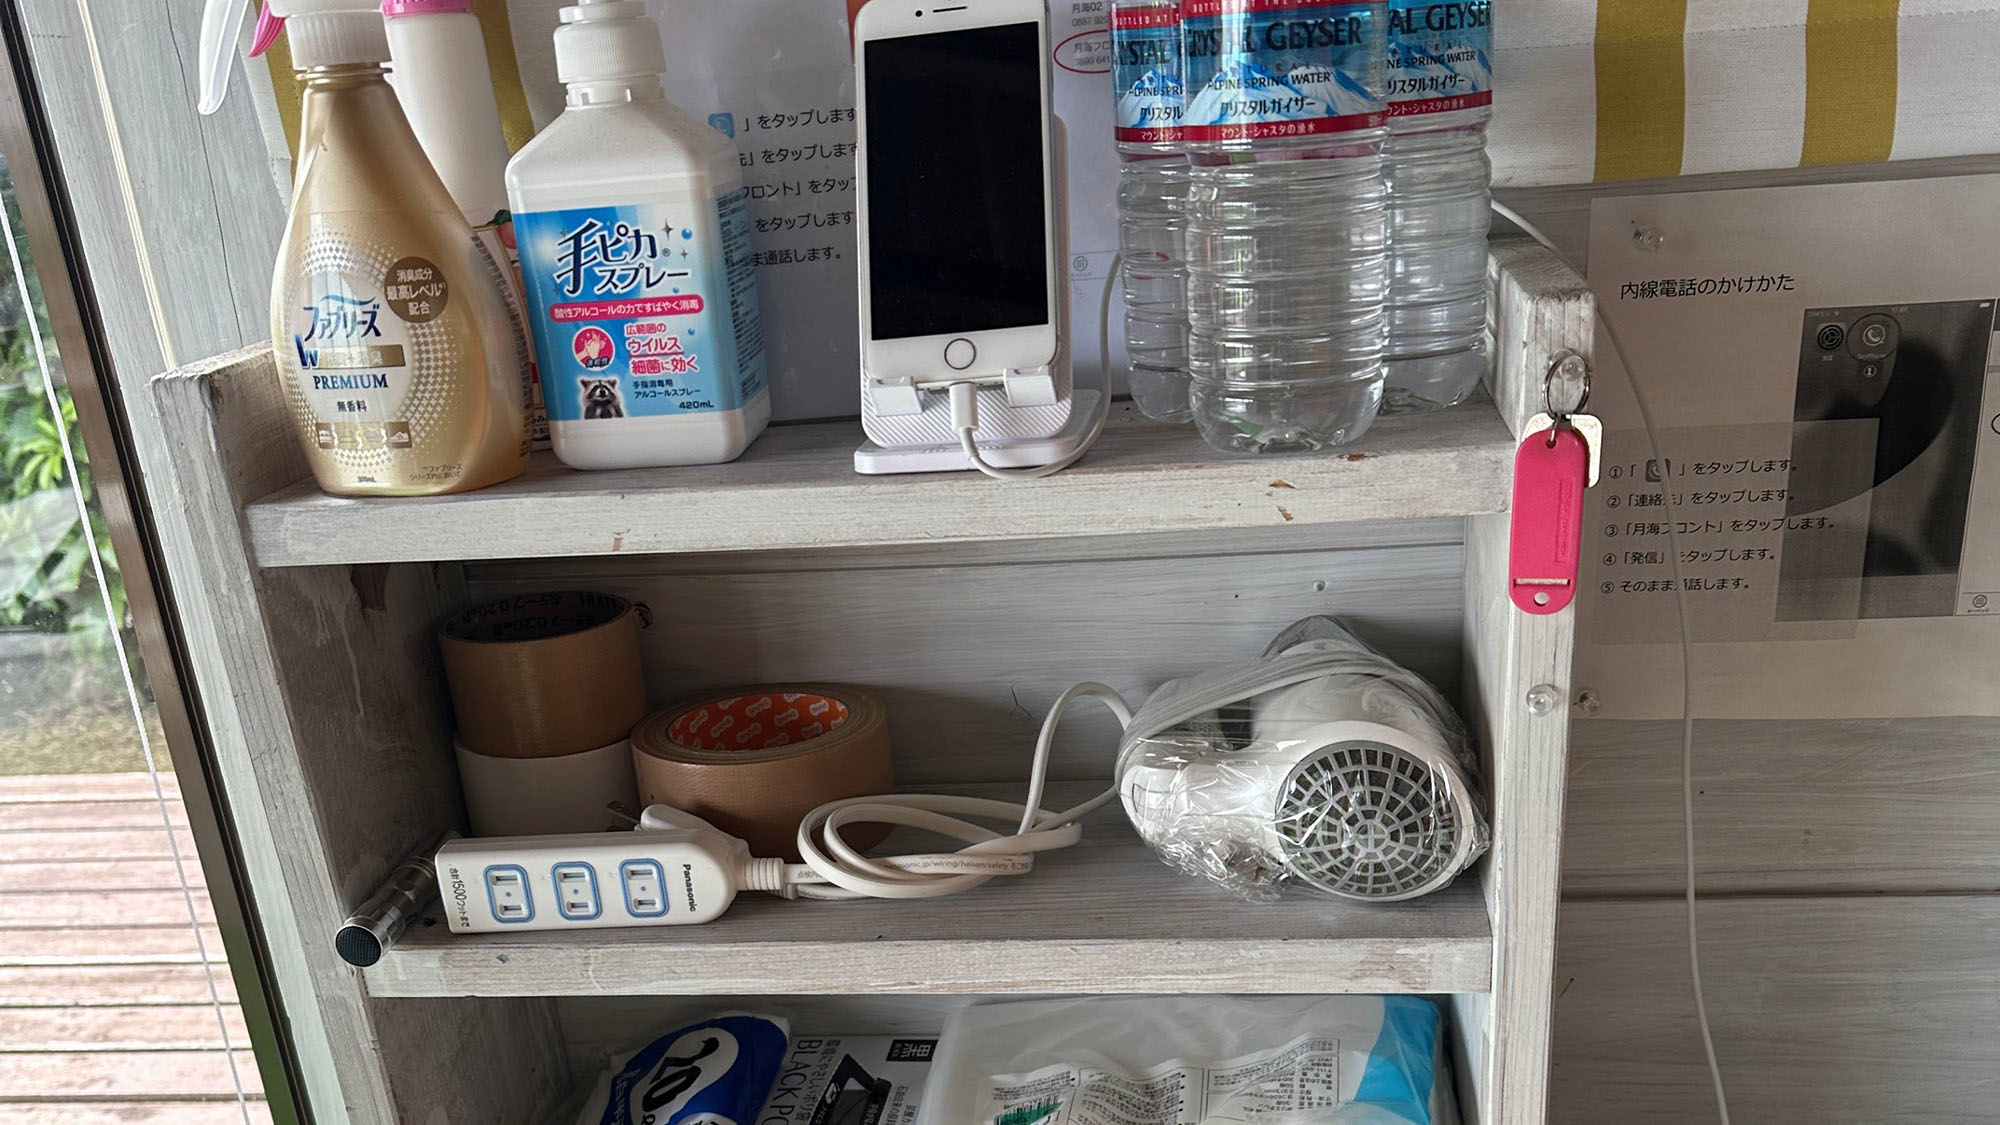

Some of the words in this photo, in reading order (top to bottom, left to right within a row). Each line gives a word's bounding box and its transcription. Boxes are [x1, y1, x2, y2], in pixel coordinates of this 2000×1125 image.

[1115, 15, 1151, 26] OTTLED
[1265, 16, 1363, 52] GEYSER
[1404, 54, 1445, 68] SPRING
[1446, 50, 1477, 63] WATER
[1245, 75, 1289, 88] SPRING
[1291, 71, 1332, 85] WATER
[1221, 95, 1317, 117] クリスタルガイザー
[396, 268, 433, 283] 消臭成分
[596, 262, 689, 292] スプレー
[1620, 274, 1796, 300] 内線電話のかけかた
[408, 302, 431, 316] 配合
[554, 299, 699, 319] 酸性アルコールの力ですばやく消毒
[303, 303, 382, 342] ファブリーズ
[625, 323, 667, 337] 広範囲の
[627, 337, 682, 355] ウイルス
[631, 355, 699, 375] 細菌に効く
[313, 373, 389, 390] PREMIUM
[632, 379, 674, 390] 手指消毒用
[634, 387, 702, 399] アルコールスプレー
[336, 400, 368, 413] 無香料
[678, 399, 715, 410] 420mL
[682, 863, 697, 913] Panasonic
[900, 1042, 932, 1059] 黒
[779, 1039, 823, 1100] BLACK
